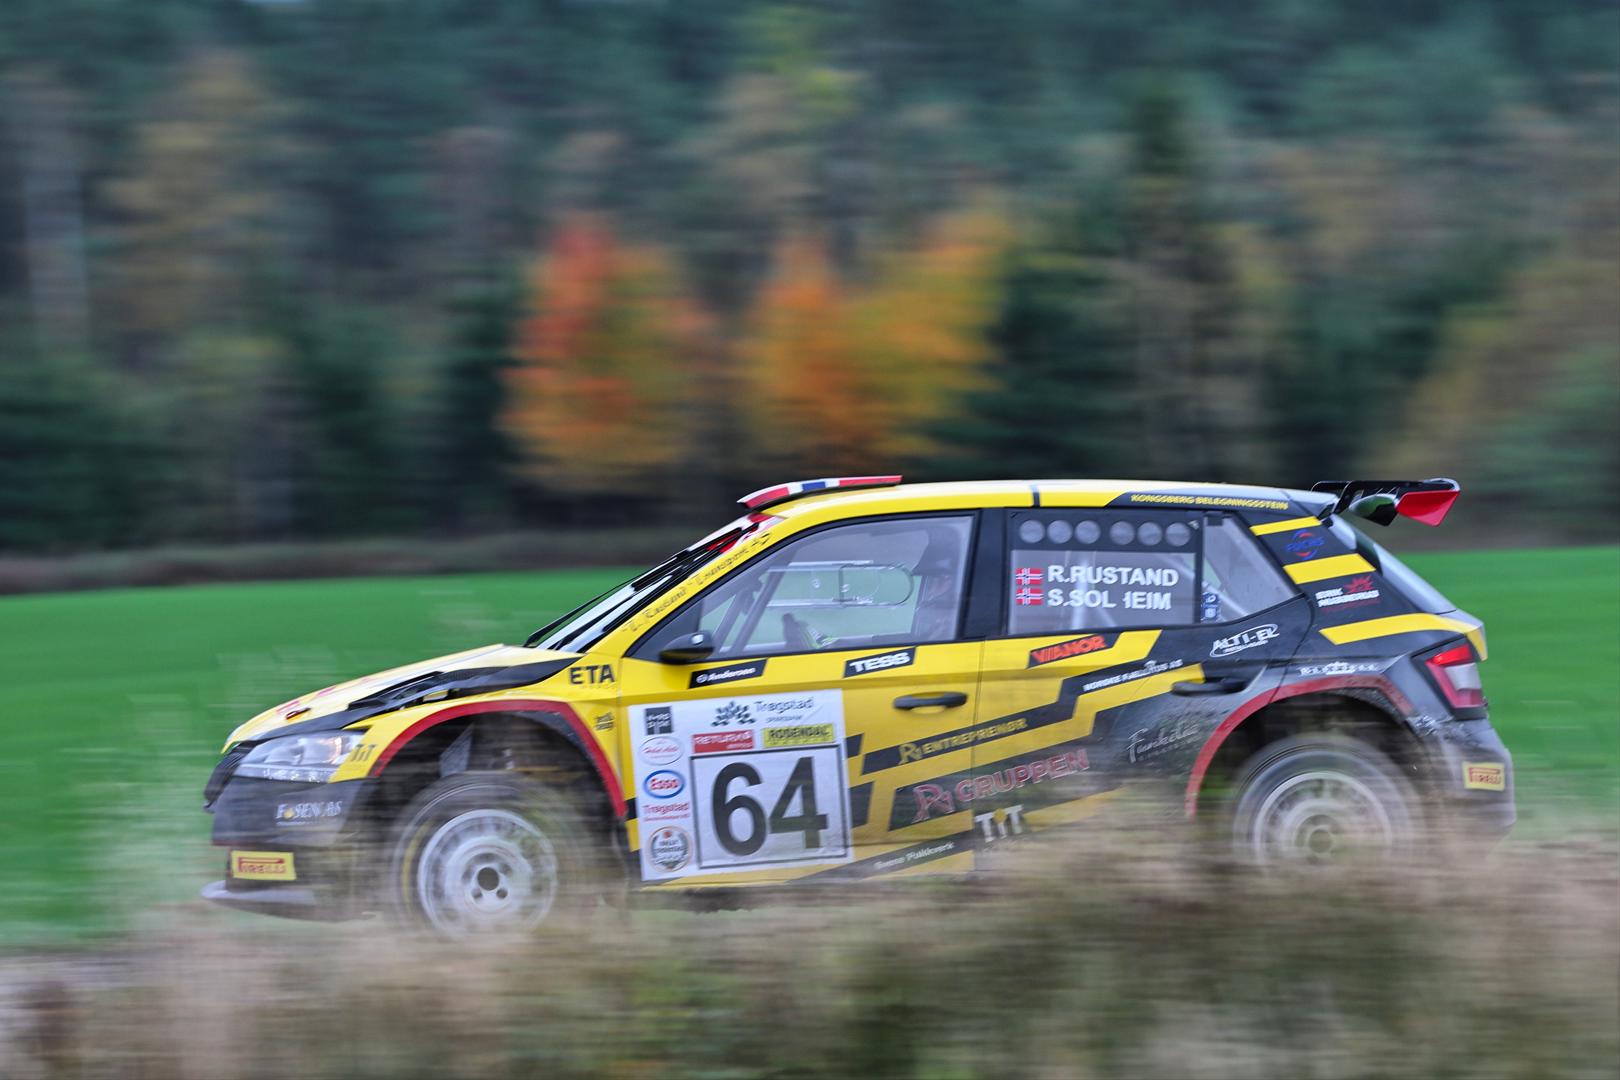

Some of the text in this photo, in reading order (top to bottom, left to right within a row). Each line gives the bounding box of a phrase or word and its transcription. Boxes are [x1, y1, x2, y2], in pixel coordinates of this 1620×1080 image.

[1048, 565, 1179, 587] R.RUSTAND
[1031, 635, 1107, 663] VIANOR
[570, 664, 615, 685] ETA
[955, 748, 1090, 802] GRUPPEN
[711, 757, 828, 857] 64
[238, 856, 286, 874] PIRELLI
